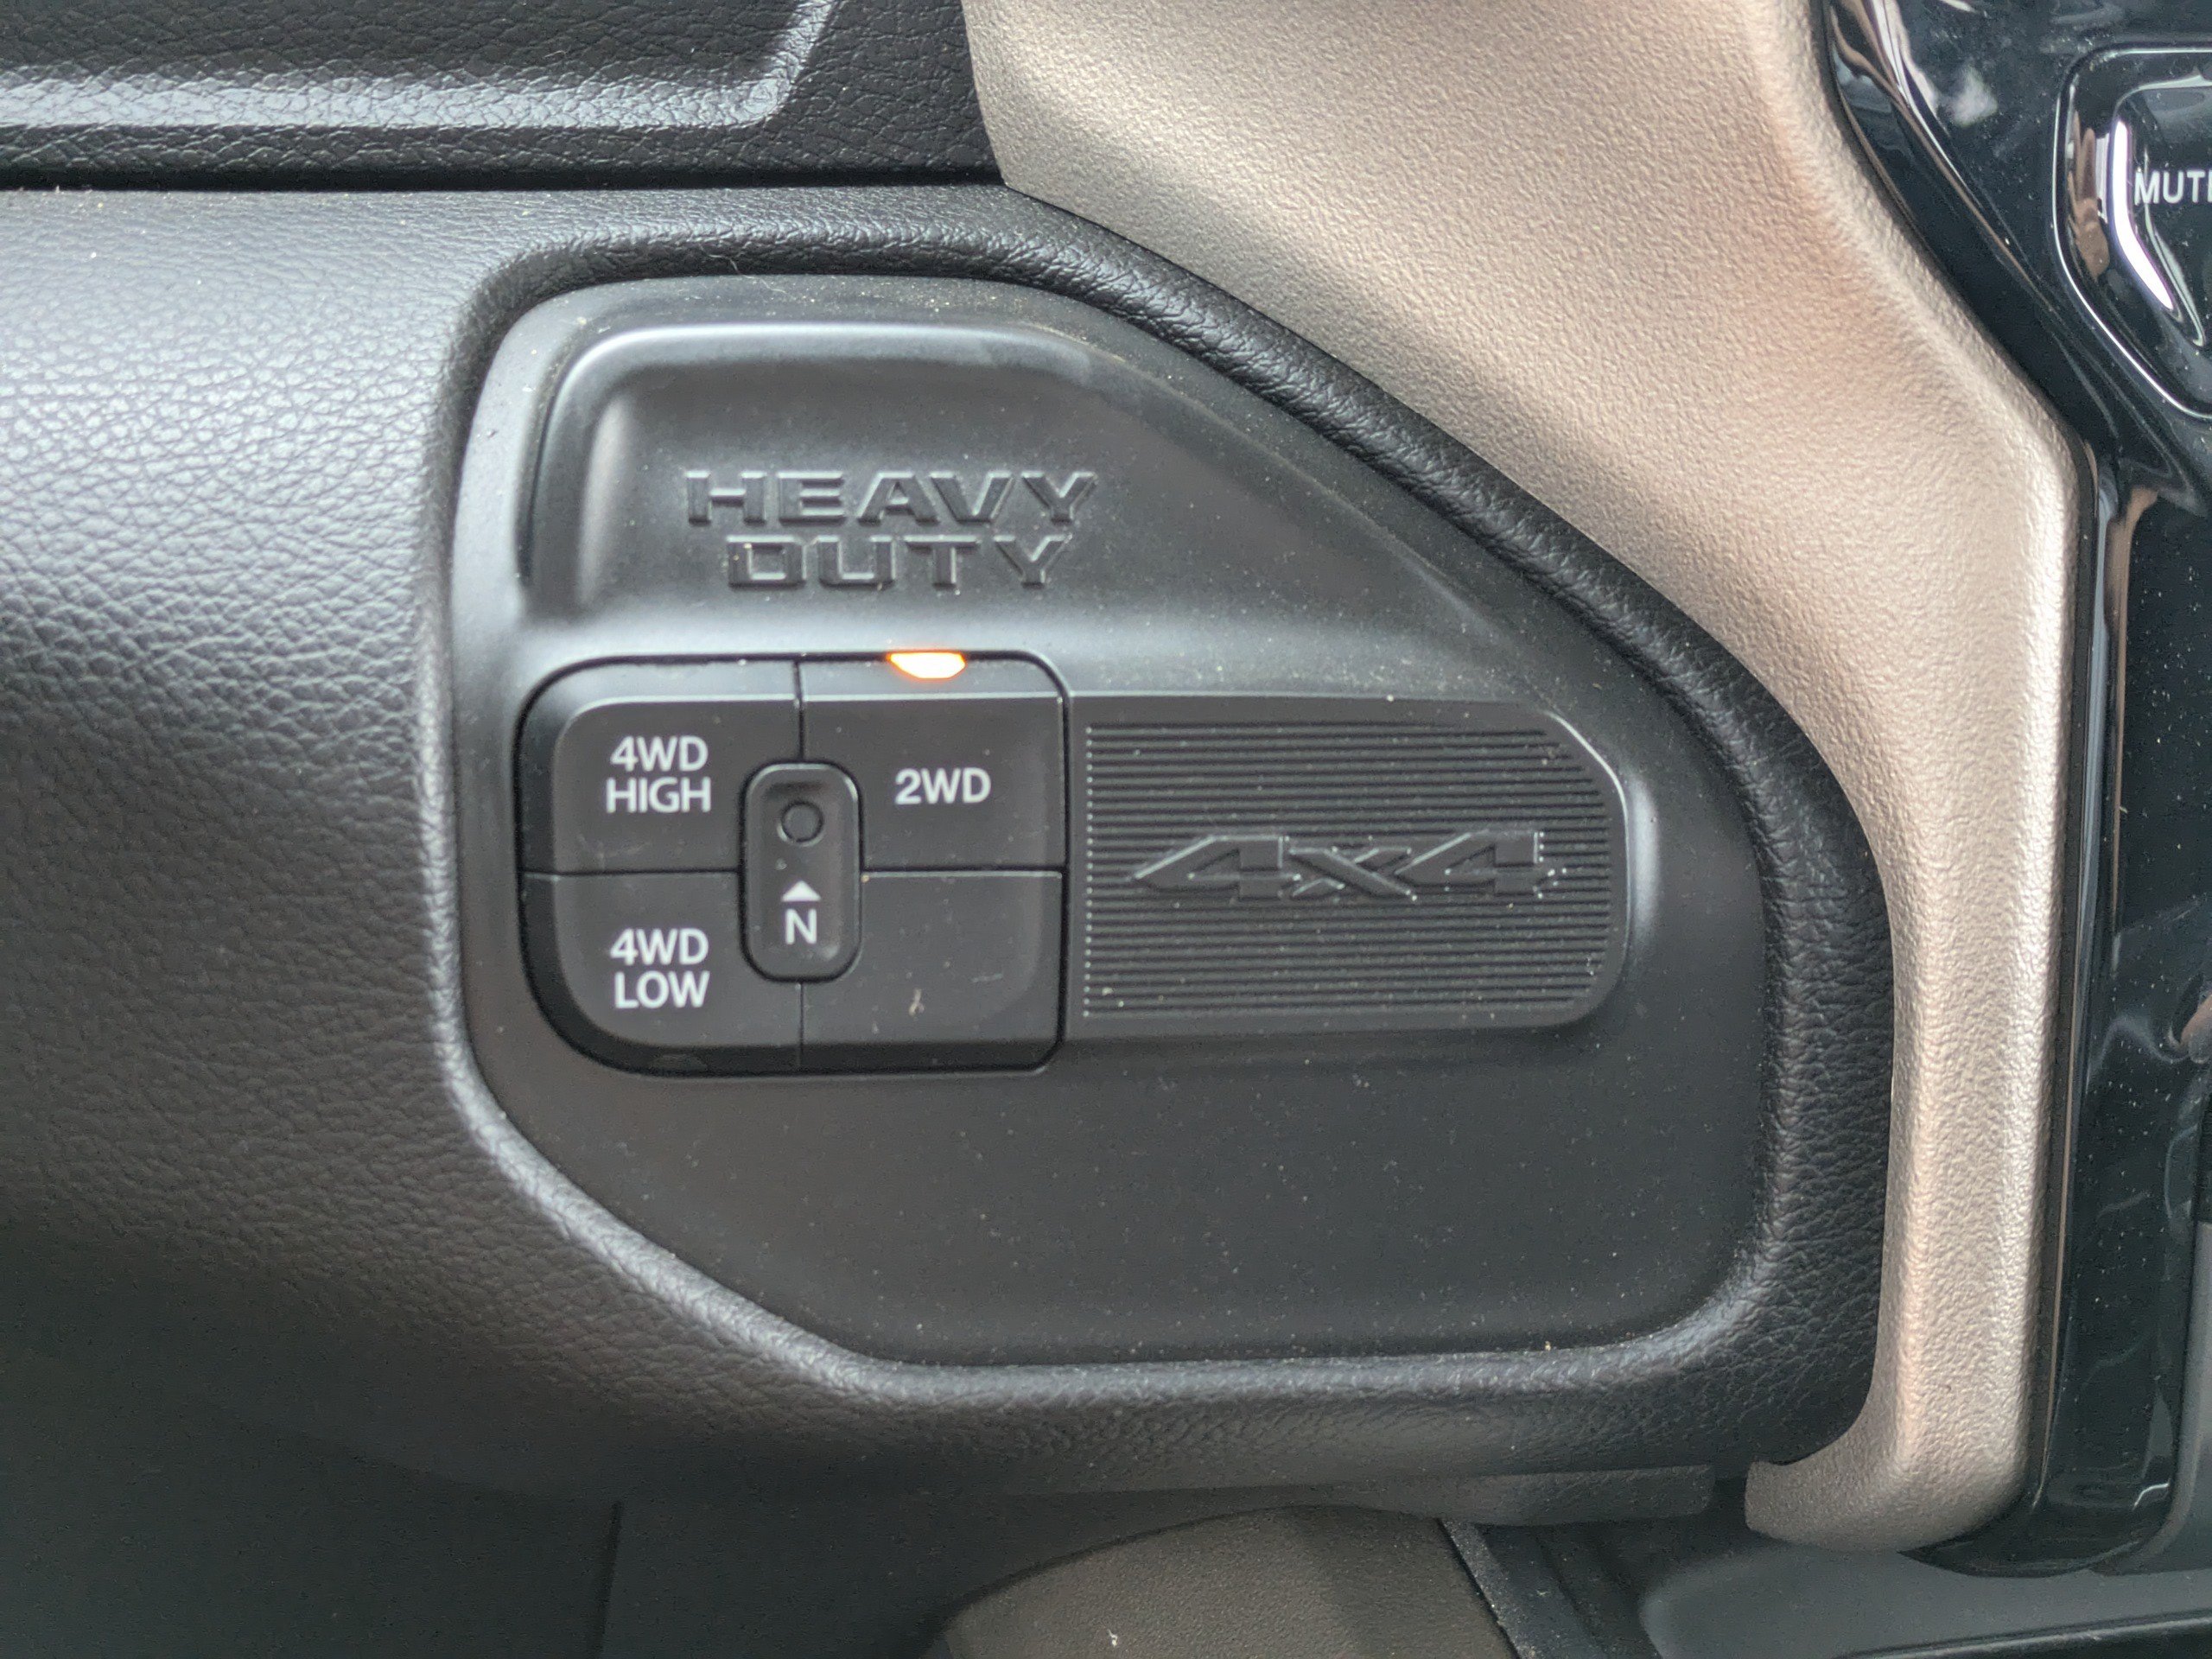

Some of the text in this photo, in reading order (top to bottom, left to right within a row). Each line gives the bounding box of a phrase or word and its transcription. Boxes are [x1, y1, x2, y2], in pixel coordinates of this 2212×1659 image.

[2134, 169, 2212, 205] MUT
[686, 470, 1097, 524] HEAVY
[727, 534, 1072, 588] DUTY
[611, 736, 709, 772] 4WD
[606, 778, 711, 813] HIGH
[895, 767, 991, 804] 2WD
[785, 909, 817, 944] N
[610, 928, 709, 965] 4WD
[614, 970, 710, 1009] LOW
